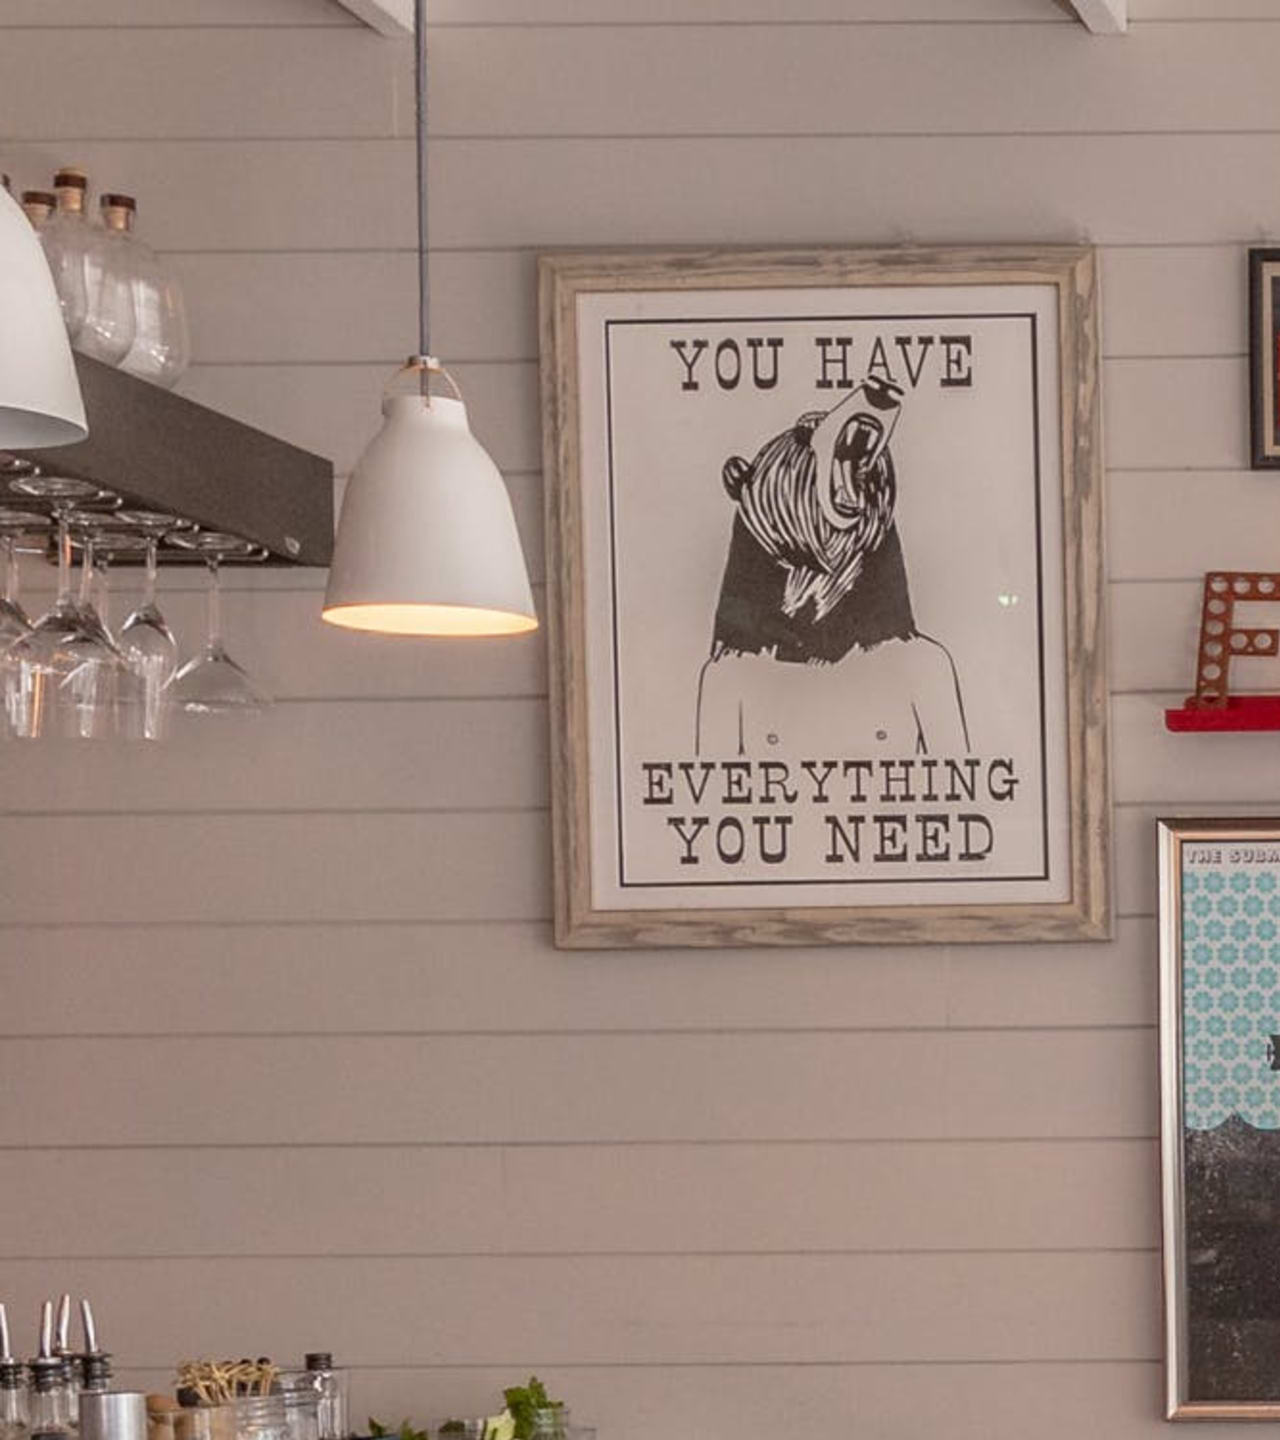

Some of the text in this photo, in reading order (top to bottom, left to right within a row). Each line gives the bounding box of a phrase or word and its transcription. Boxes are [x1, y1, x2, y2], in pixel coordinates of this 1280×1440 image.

[670, 335, 973, 390] YOU HAVE
[642, 757, 1020, 805] EVERYTHING
[668, 814, 995, 864] YOU NEED
[1188, 849, 1223, 865] THE
